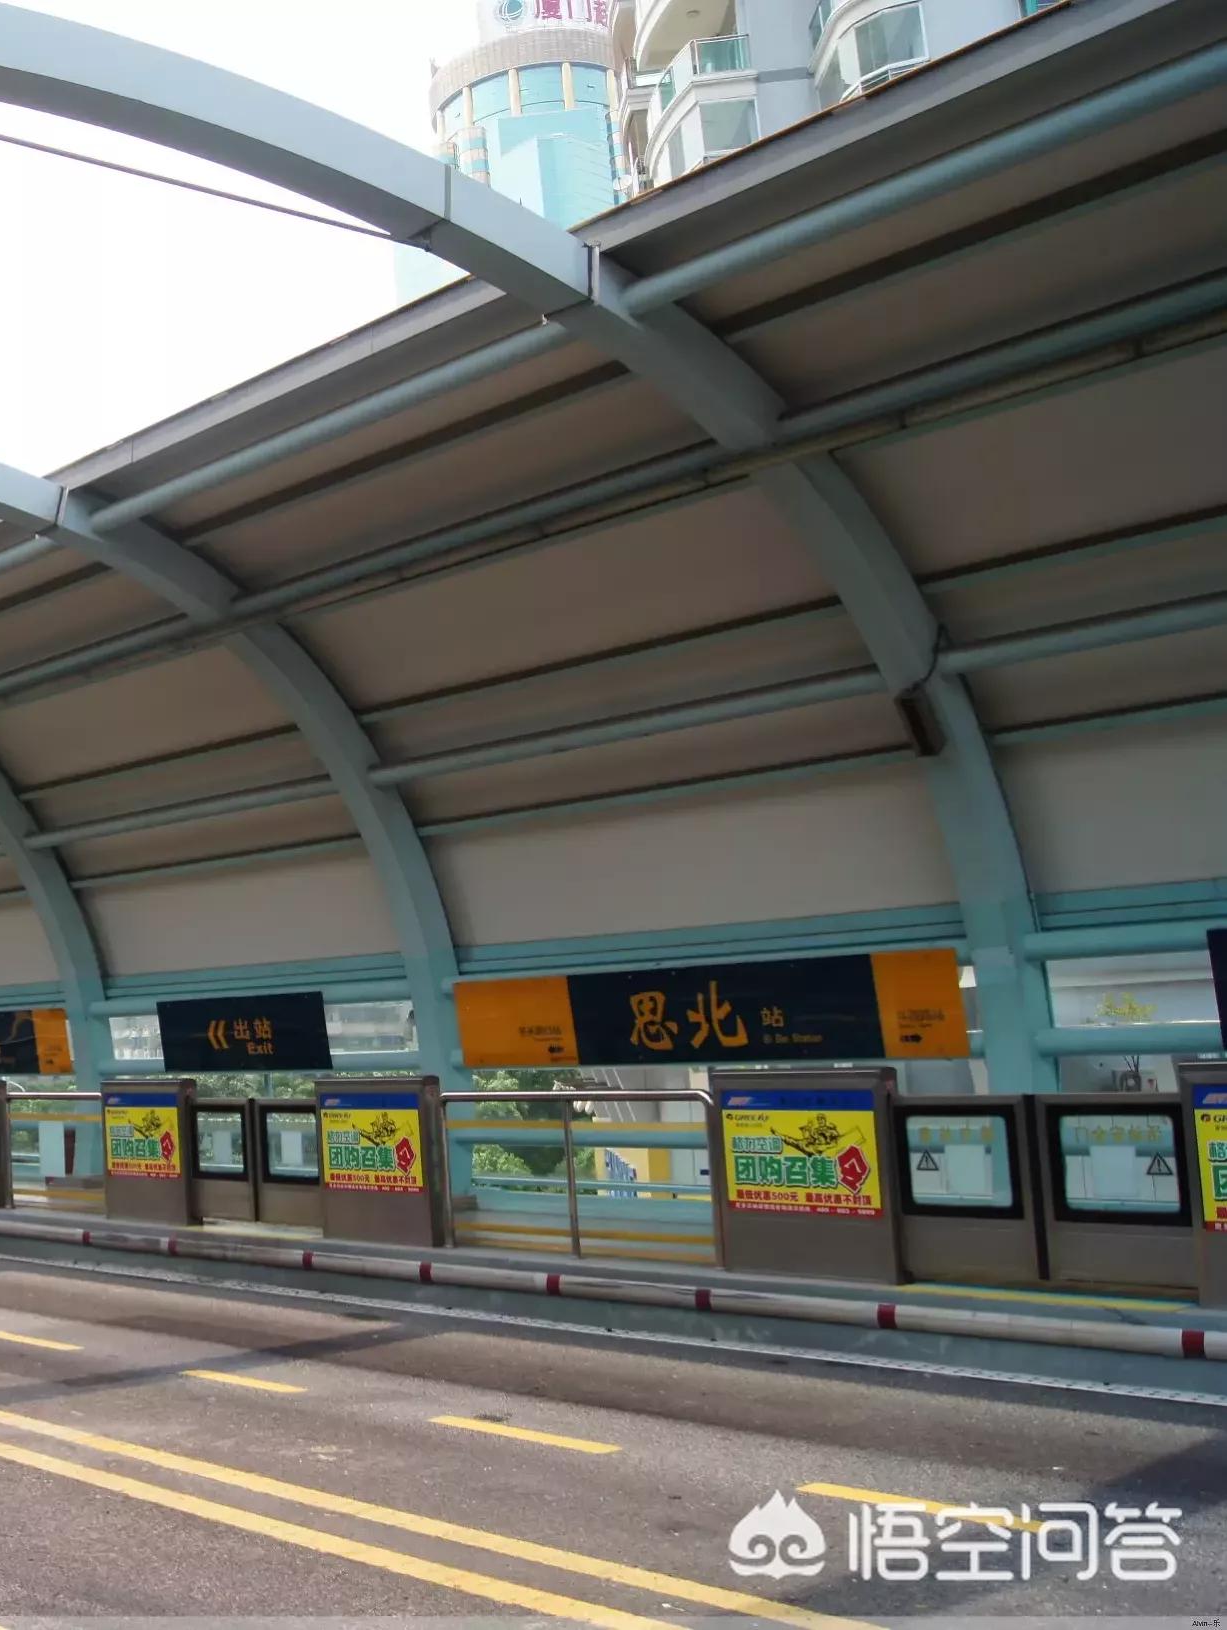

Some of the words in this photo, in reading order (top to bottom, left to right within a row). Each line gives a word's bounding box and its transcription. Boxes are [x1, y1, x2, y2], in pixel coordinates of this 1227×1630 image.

[629, 979, 750, 1050] 思北
[233, 1017, 272, 1040] 出站
[246, 1041, 274, 1055] Exit
